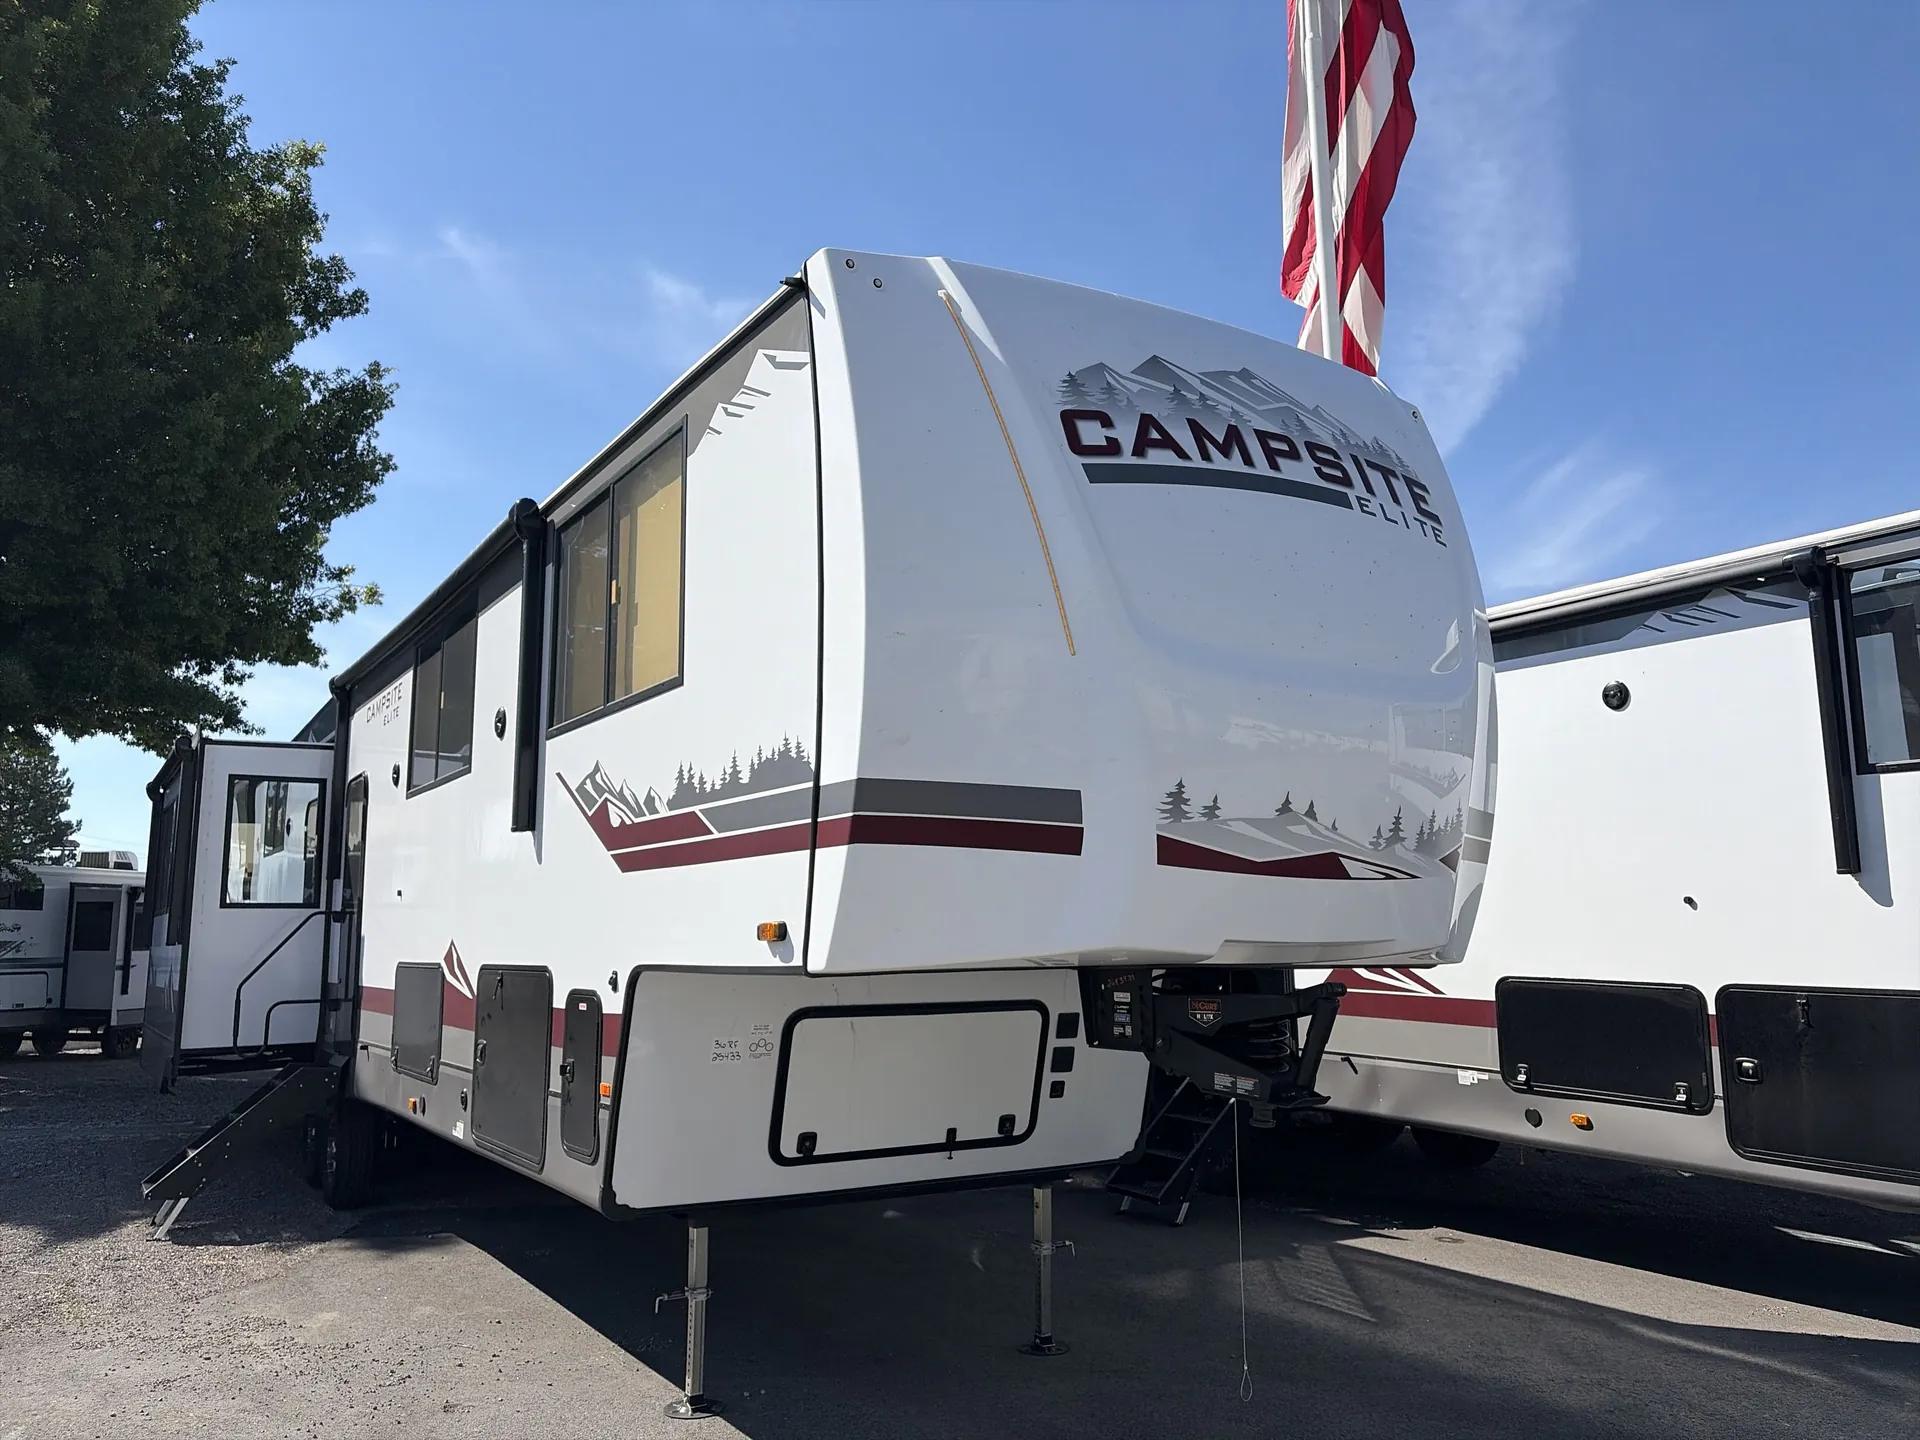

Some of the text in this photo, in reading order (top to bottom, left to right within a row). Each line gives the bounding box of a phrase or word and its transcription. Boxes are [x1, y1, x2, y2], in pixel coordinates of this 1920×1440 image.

[1060, 408, 1443, 527] CAMPSITE
[1355, 494, 1448, 549] ELITE
[366, 682, 403, 723] CAMPSITE
[383, 706, 400, 726] ELITE
